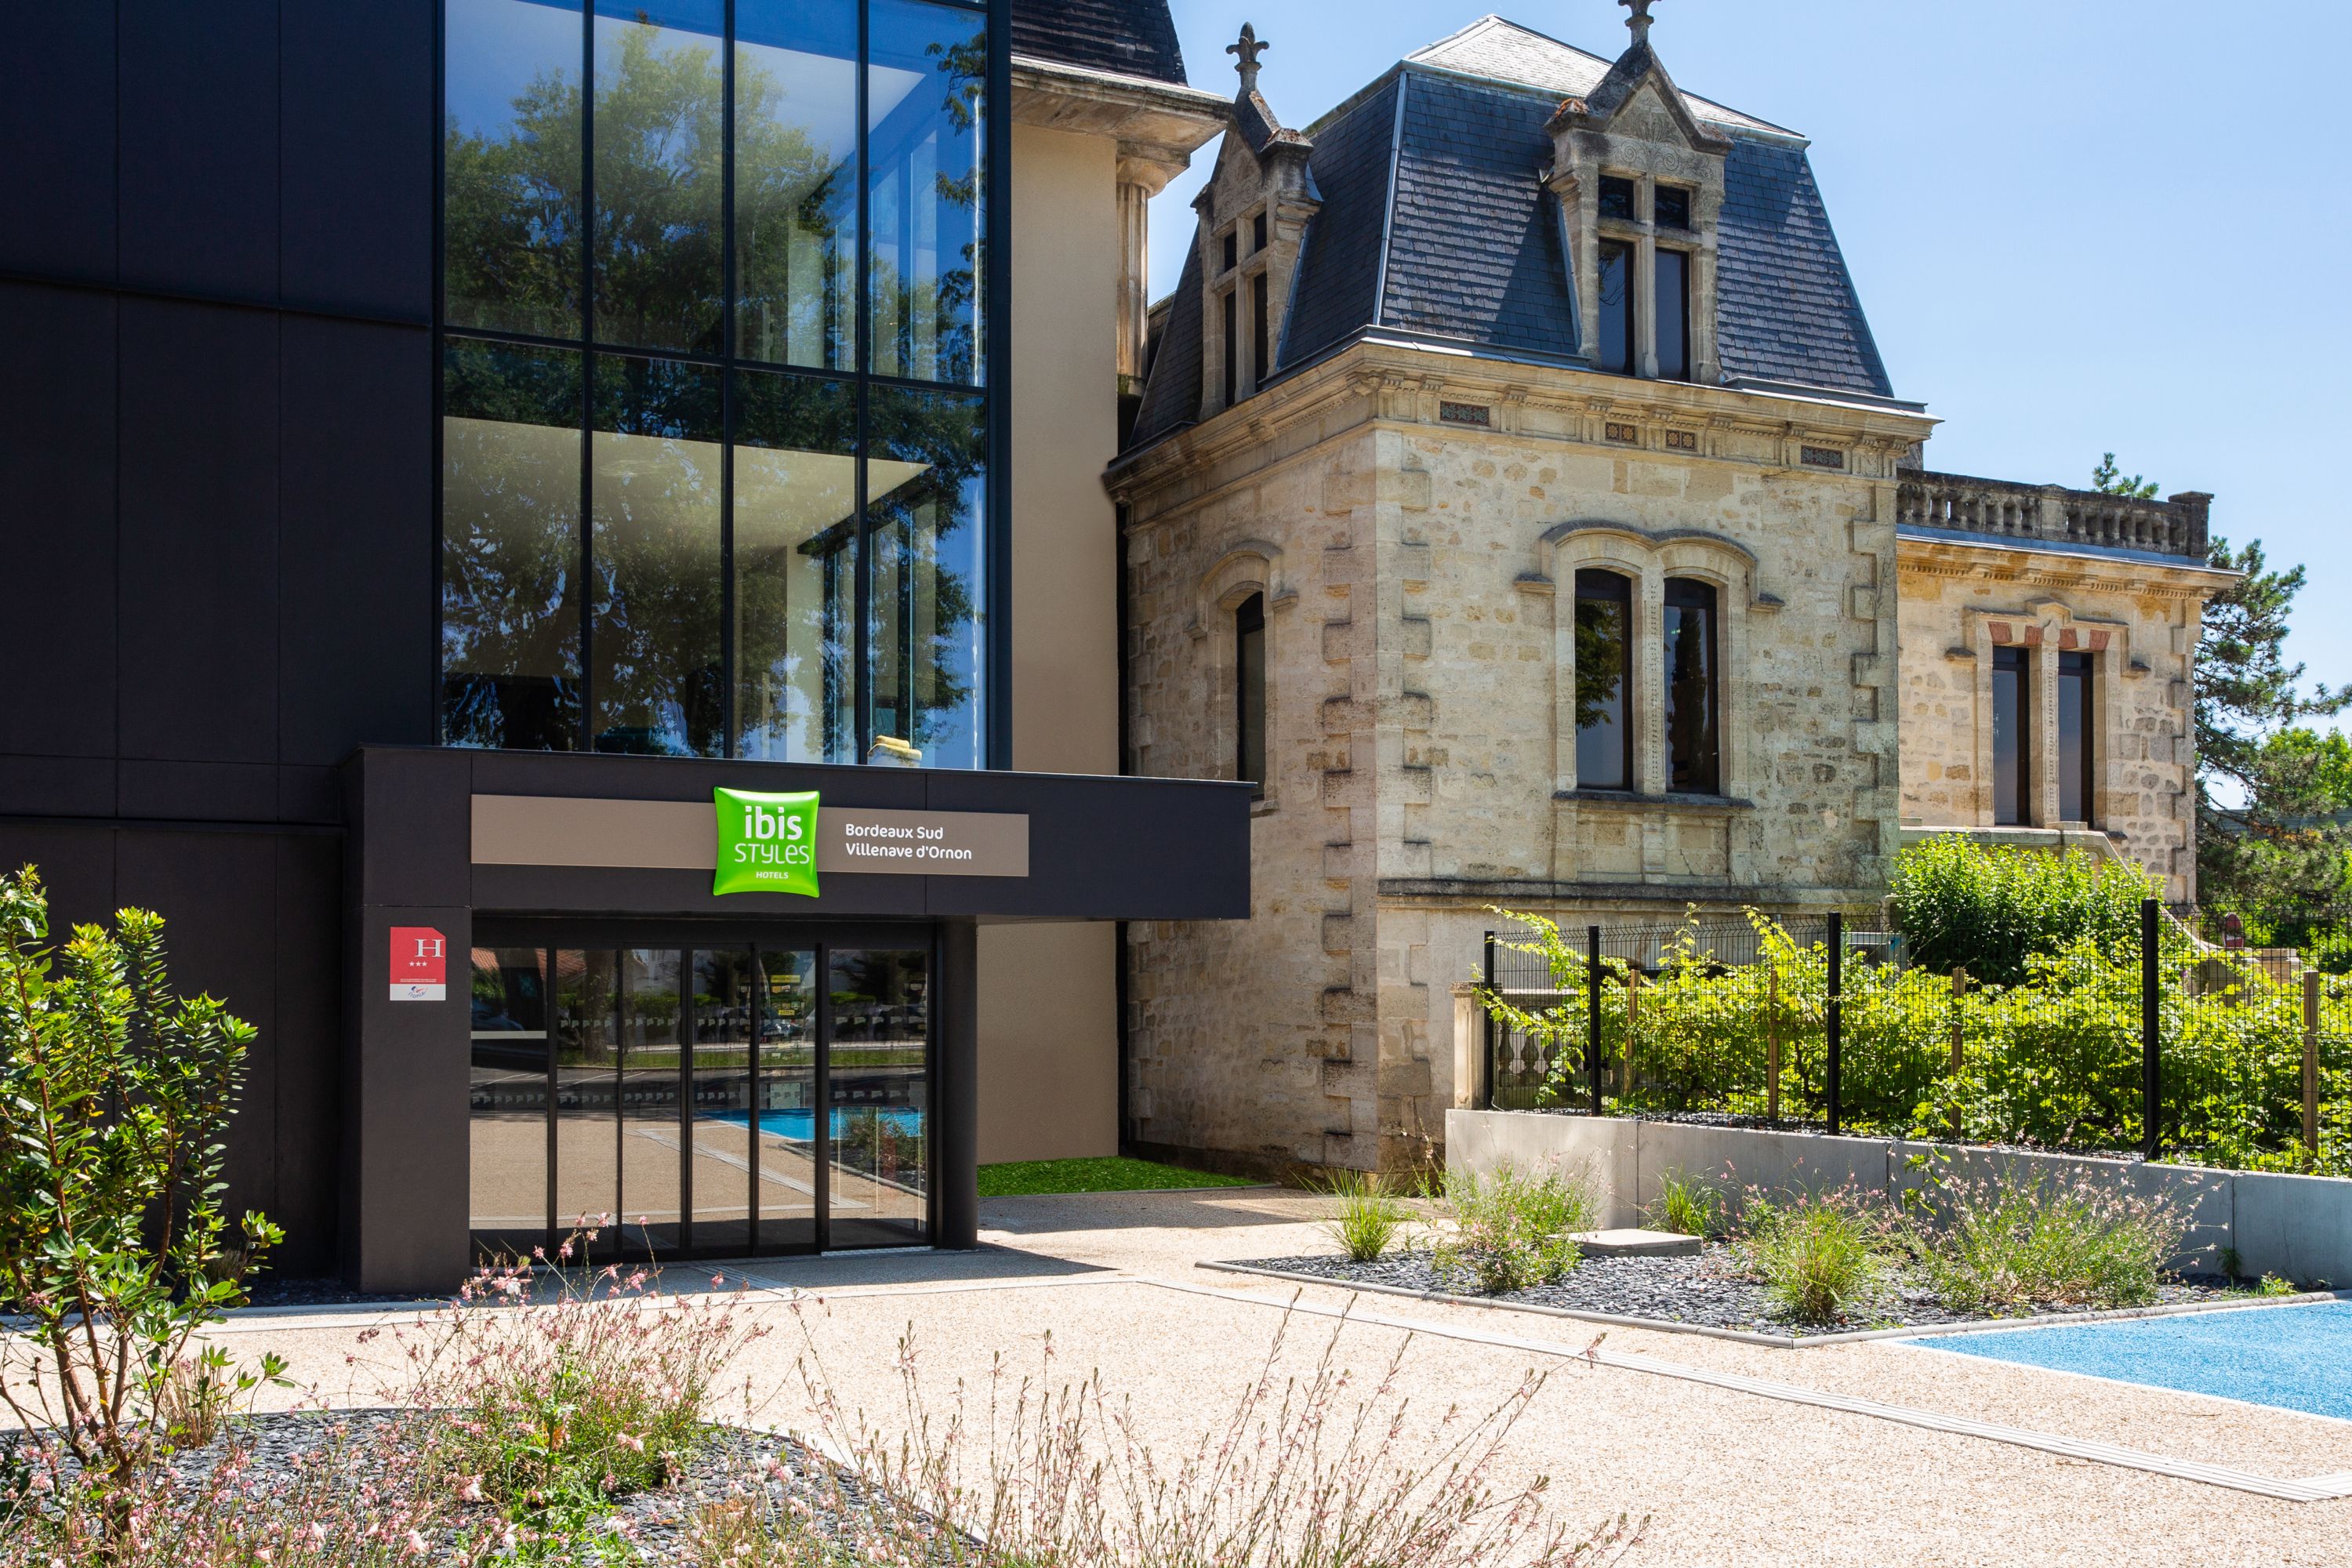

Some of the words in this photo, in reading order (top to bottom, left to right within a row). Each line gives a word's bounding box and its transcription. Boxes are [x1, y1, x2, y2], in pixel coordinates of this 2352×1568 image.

[745, 805, 803, 840] ibis
[845, 823, 913, 839] Bordeaux
[916, 826, 944, 840] Sud
[845, 843, 913, 858] Villenave
[916, 845, 972, 860] d'Ornon
[414, 938, 445, 958] H
